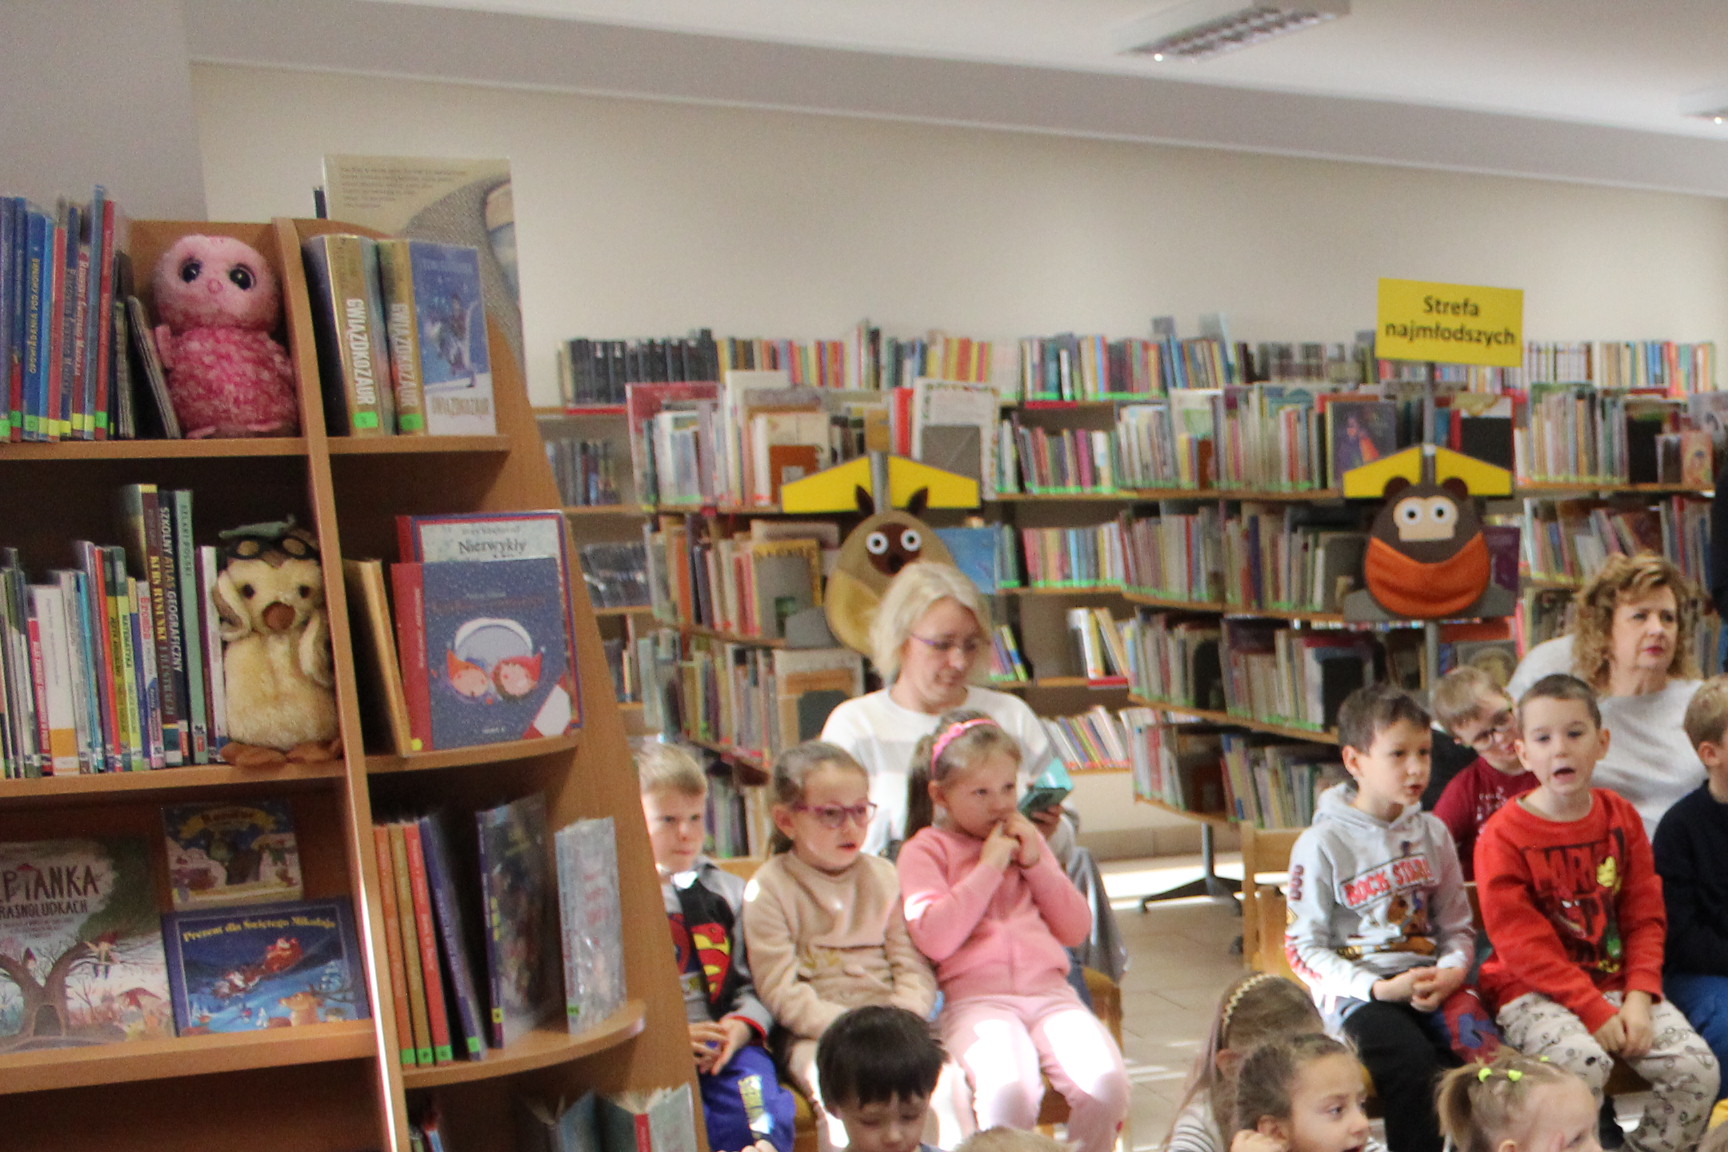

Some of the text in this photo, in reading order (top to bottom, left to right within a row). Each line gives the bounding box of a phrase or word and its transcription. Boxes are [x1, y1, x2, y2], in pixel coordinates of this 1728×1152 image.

[1423, 294, 1481, 318] Strefa
[1384, 319, 1517, 347] najmłodszych
[2, 864, 100, 903] PIANKA
[1343, 868, 1392, 907] ROCK
